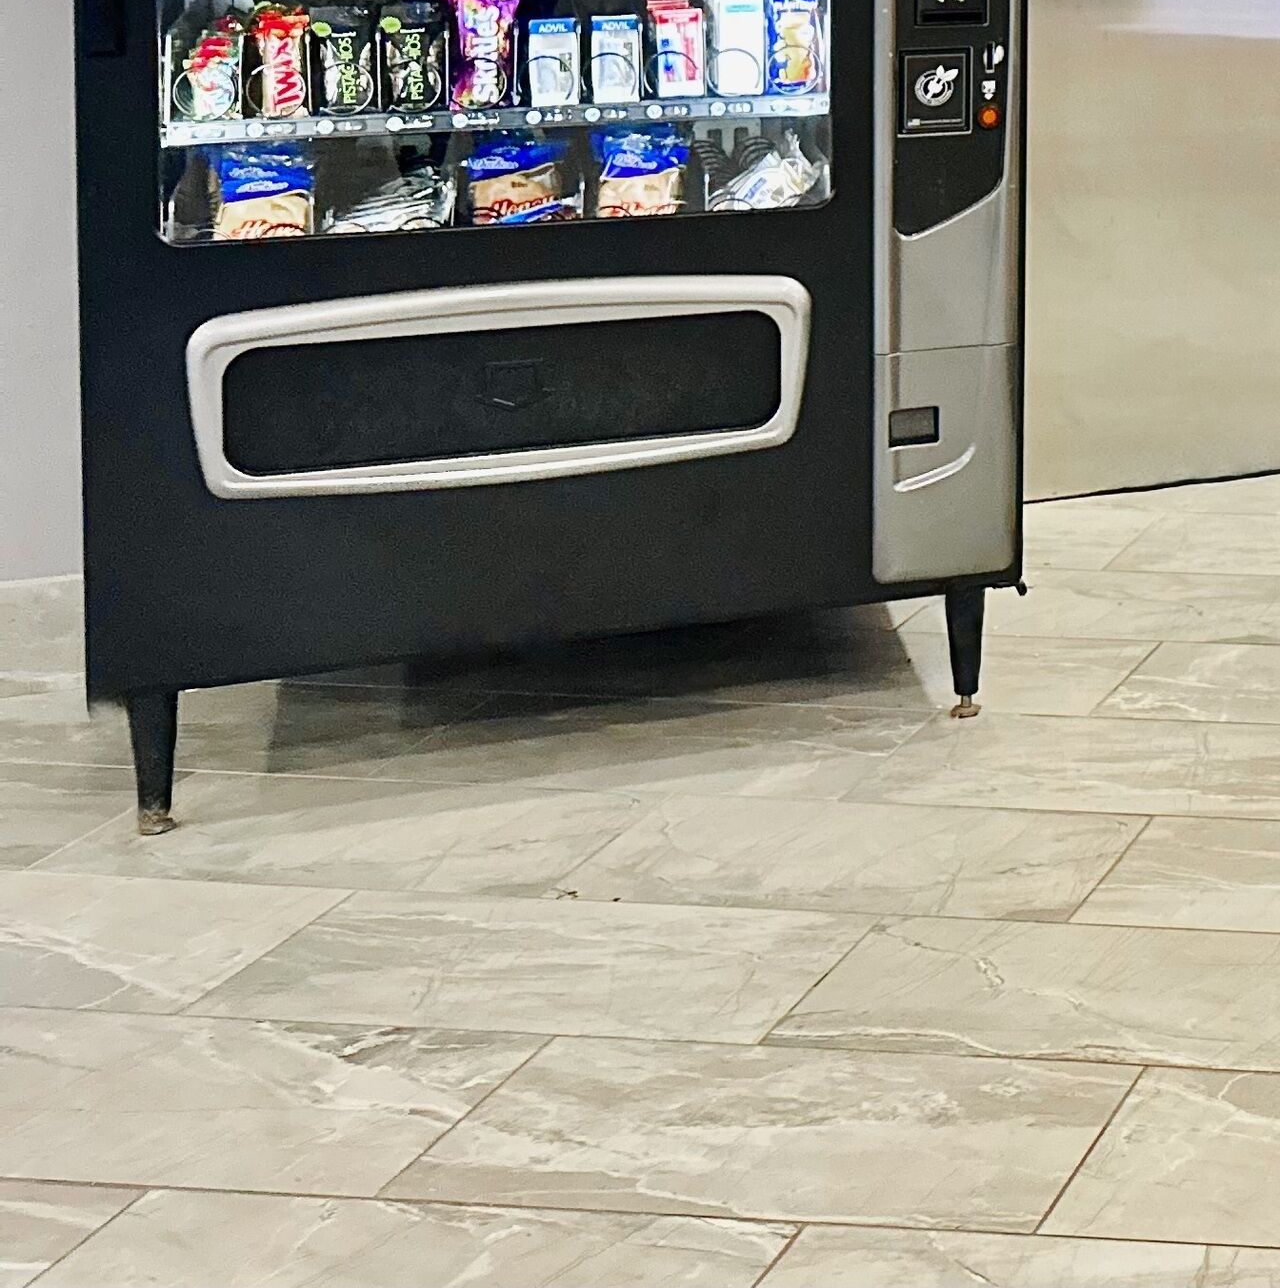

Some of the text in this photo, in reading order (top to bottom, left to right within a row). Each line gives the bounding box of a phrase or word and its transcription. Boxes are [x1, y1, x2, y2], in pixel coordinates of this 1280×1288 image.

[538, 23, 568, 33] ADVIL
[601, 20, 630, 31] ADVIL
[273, 40, 301, 108] TWIX
